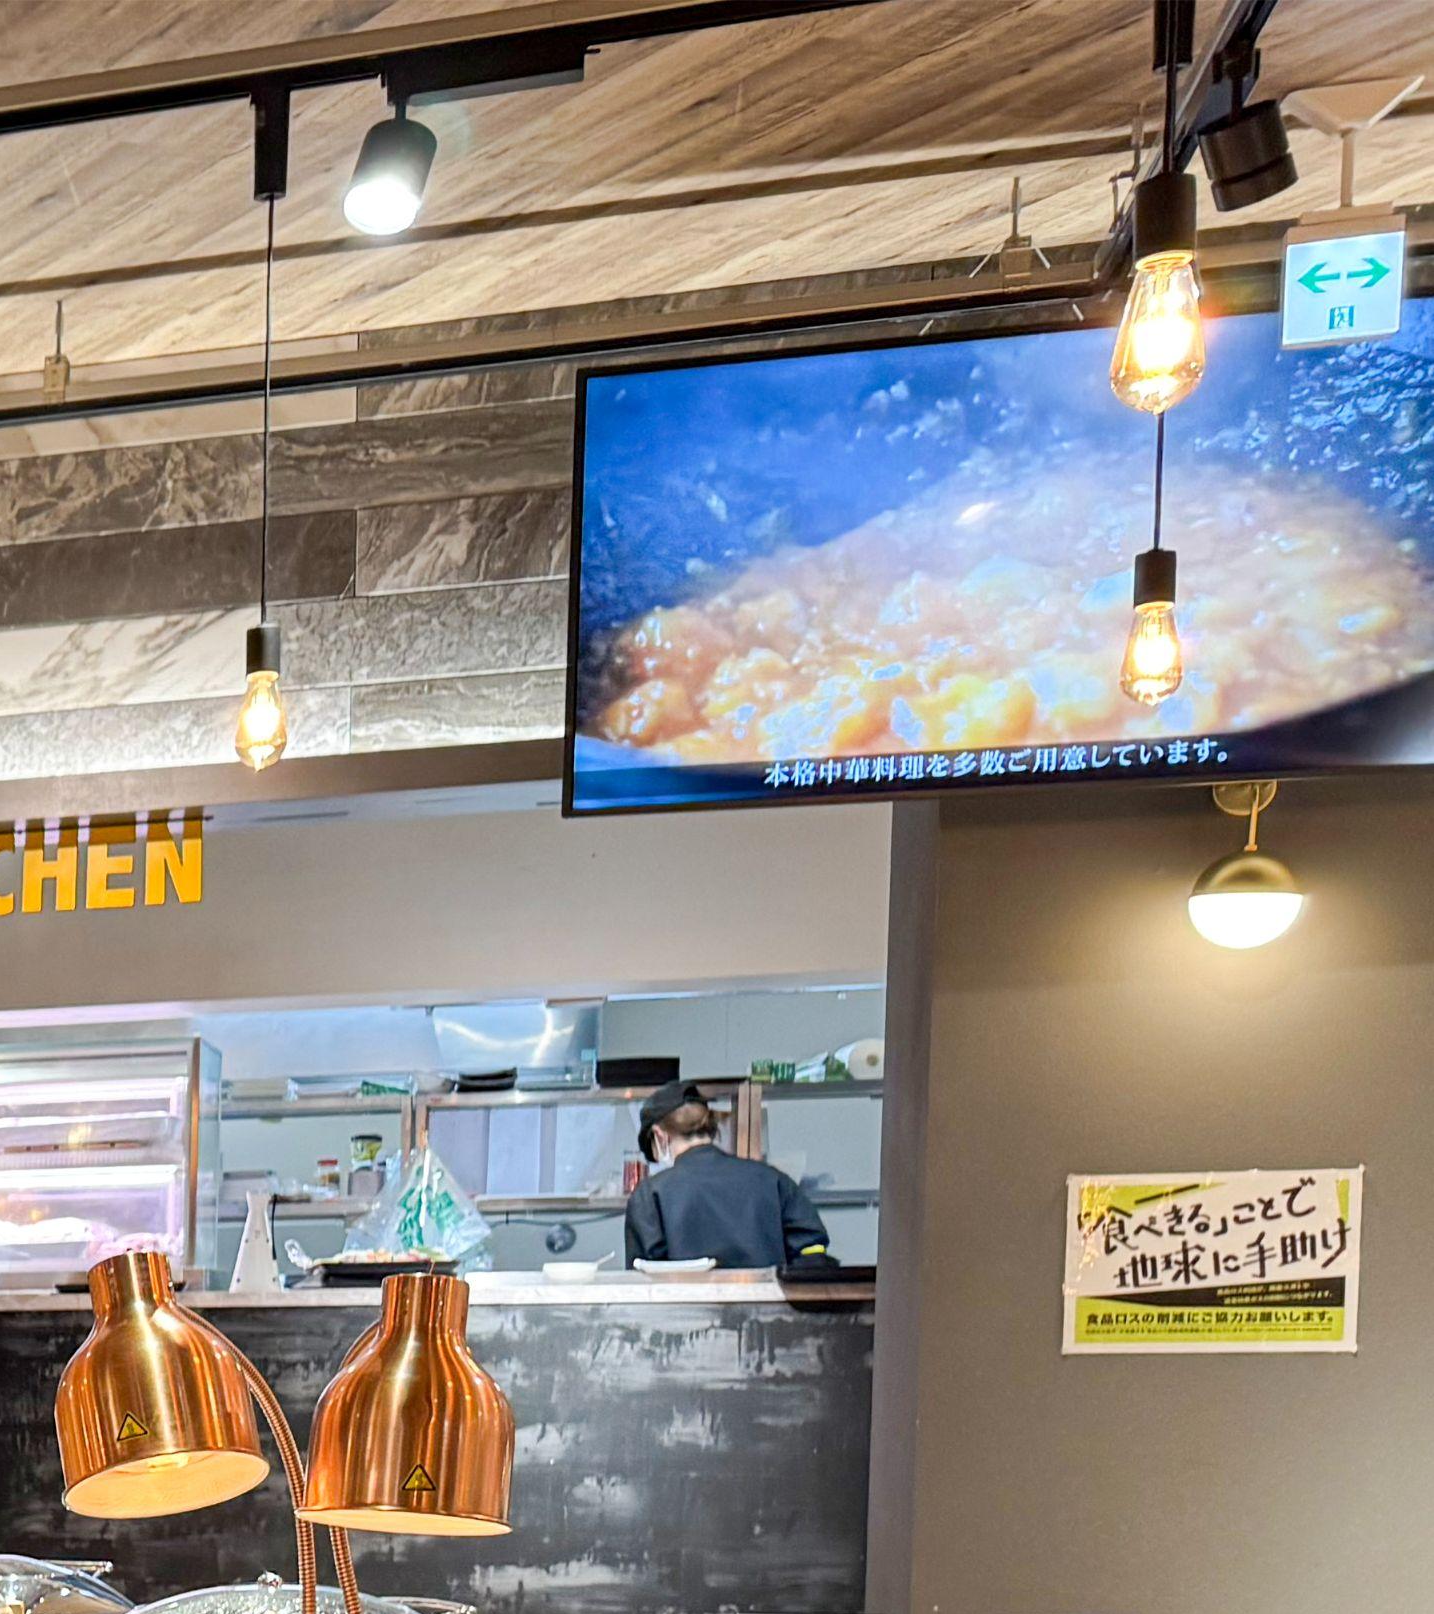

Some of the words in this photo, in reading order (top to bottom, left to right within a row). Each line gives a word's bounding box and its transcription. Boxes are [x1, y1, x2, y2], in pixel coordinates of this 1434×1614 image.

[764, 738, 1228, 789] 本格中華料理を多数ご用意しています。
[1112, 1216, 1352, 1289] 地球に手助け
[1086, 1310, 1334, 1326] 食品ロスの削減にご協力お願いします。
